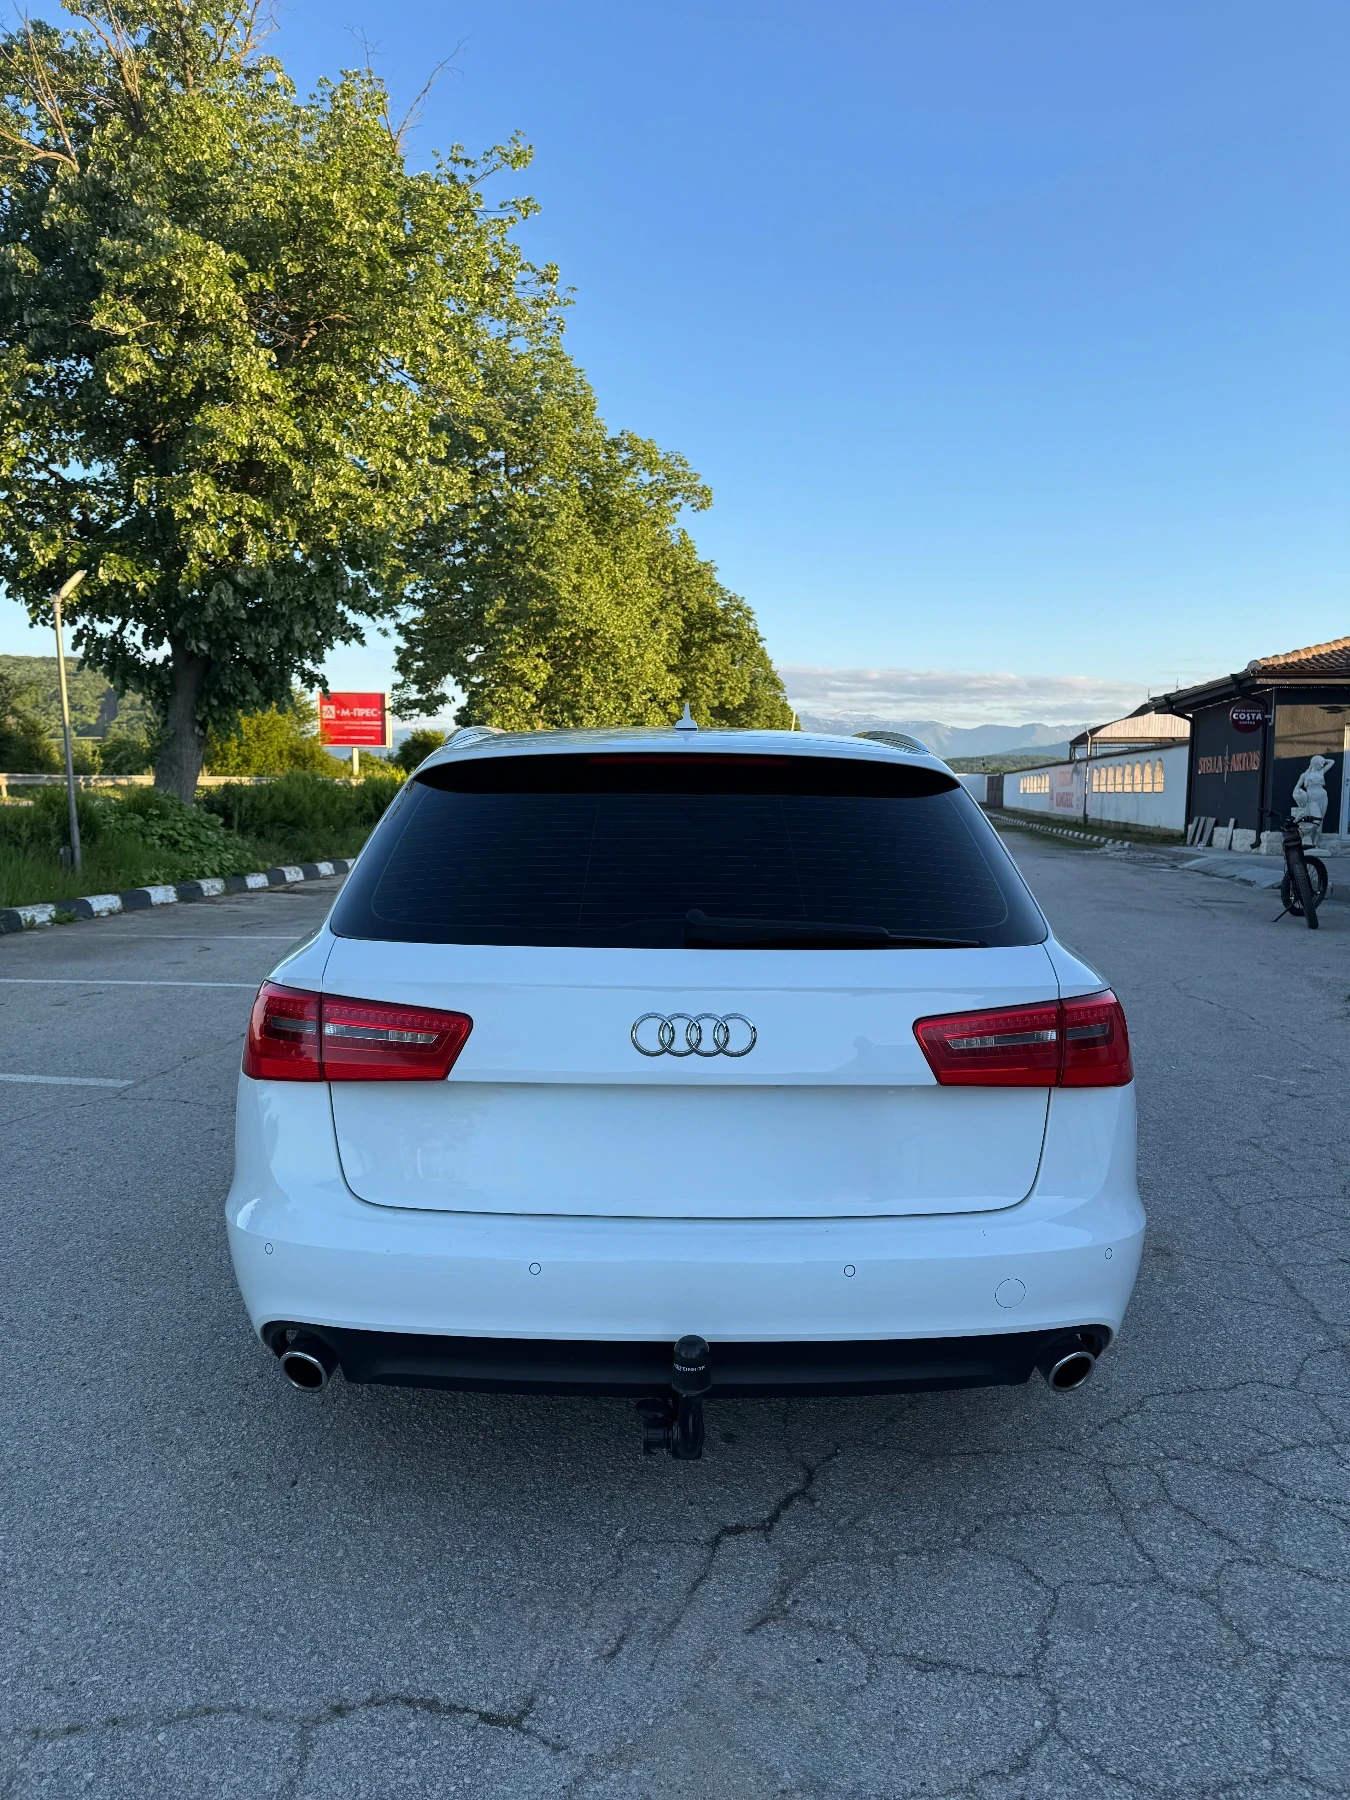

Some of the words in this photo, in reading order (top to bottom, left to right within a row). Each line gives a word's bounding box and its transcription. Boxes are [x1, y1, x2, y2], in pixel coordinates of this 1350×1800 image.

[340, 707, 378, 717] М-ПРЕС
[1233, 712, 1263, 721] COSTA
[1198, 755, 1223, 775] STELLA
[1230, 750, 1261, 772] ARTOIS
